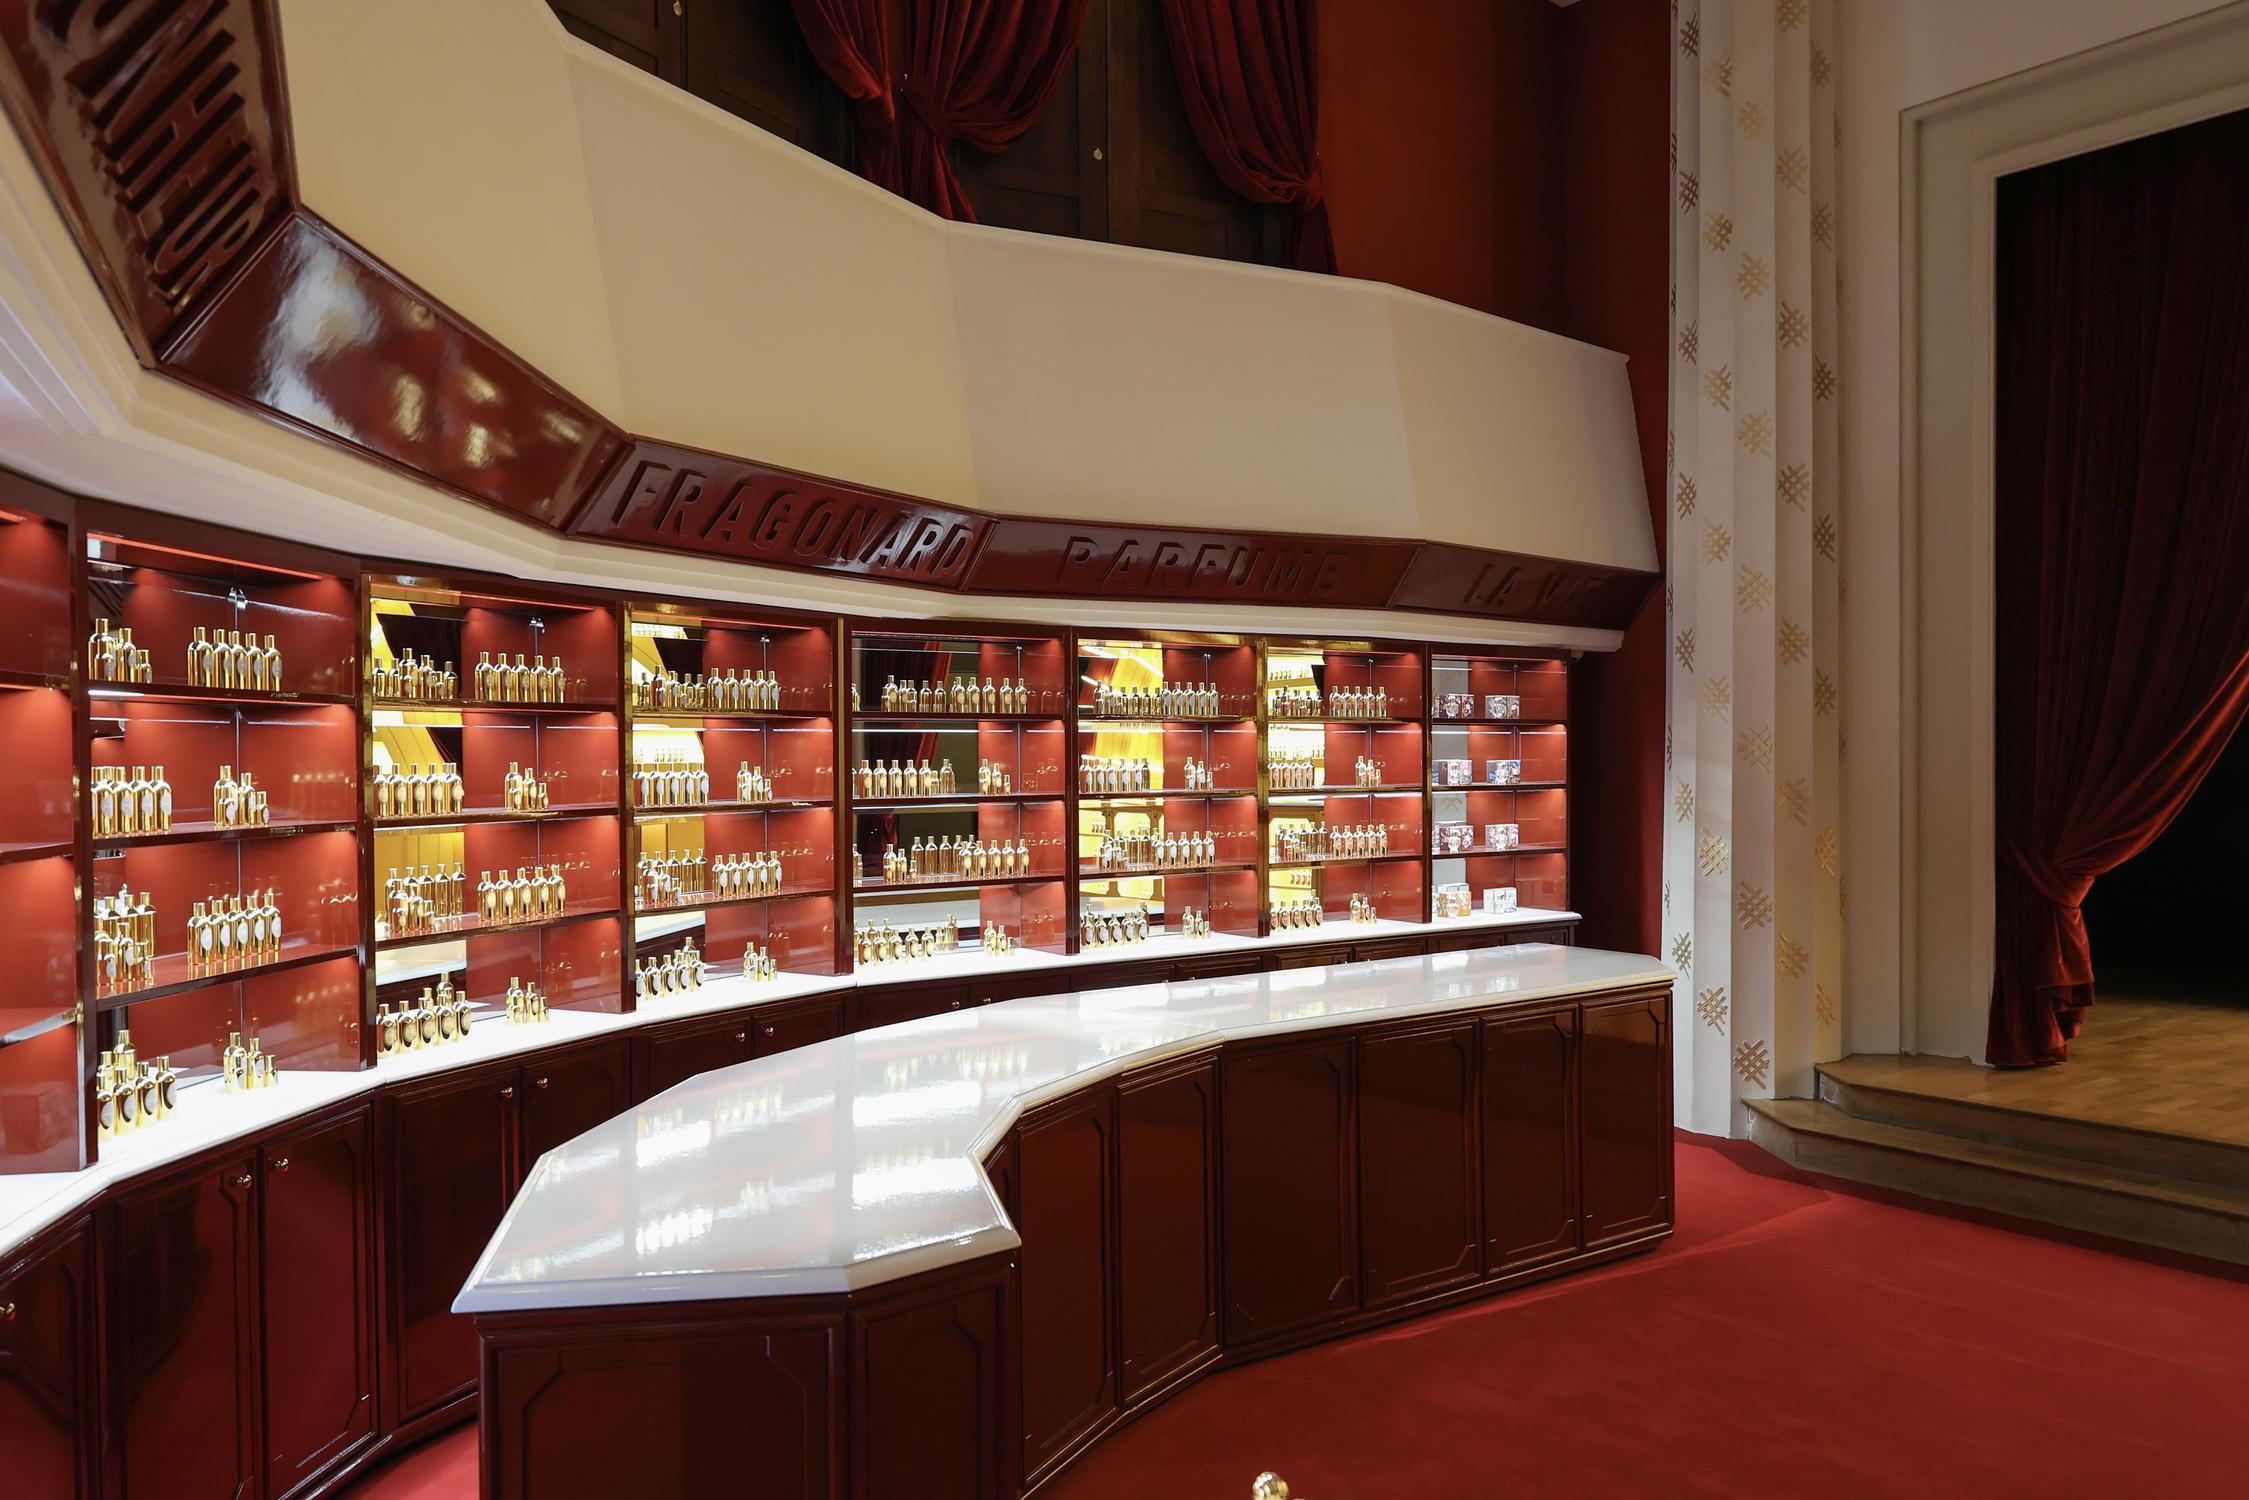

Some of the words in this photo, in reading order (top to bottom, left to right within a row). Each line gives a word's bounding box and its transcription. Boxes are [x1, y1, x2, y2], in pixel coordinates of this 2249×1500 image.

[611, 460, 976, 576] FRAGONARD
[1057, 535, 1351, 596] PARFUME
[1462, 562, 1522, 607] LA
